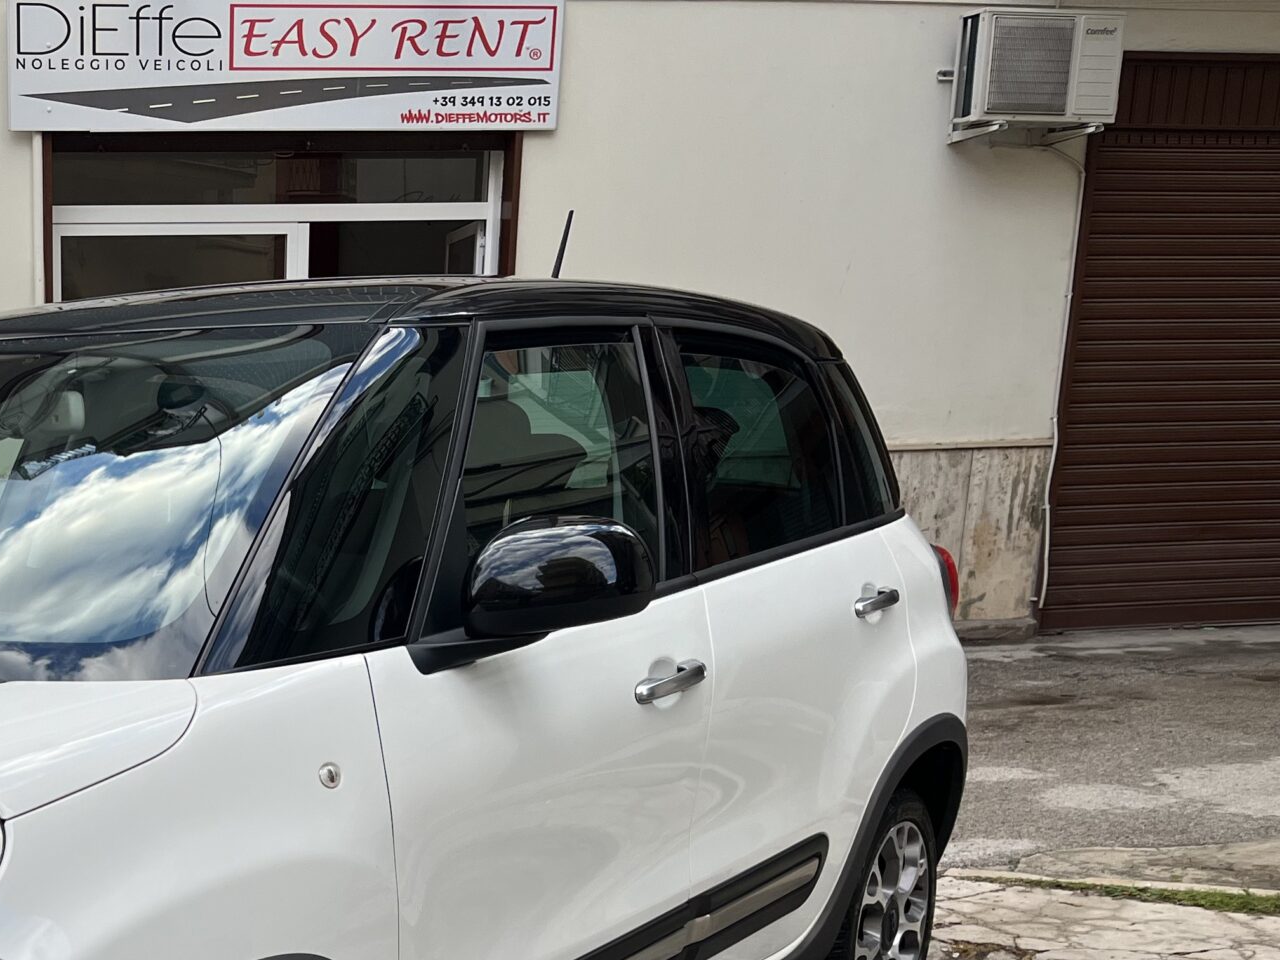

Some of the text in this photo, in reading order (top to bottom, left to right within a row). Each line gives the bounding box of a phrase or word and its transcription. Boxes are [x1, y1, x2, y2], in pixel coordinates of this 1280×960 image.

[16, 2, 222, 57] DiEffe
[241, 17, 377, 59] EASY
[16, 58, 223, 71] NOLEGGIO VEICOLI
[432, 95, 551, 107] +39 349 13 02 015
[400, 109, 550, 124] WWW.DIEFFEMOTORS.IT
